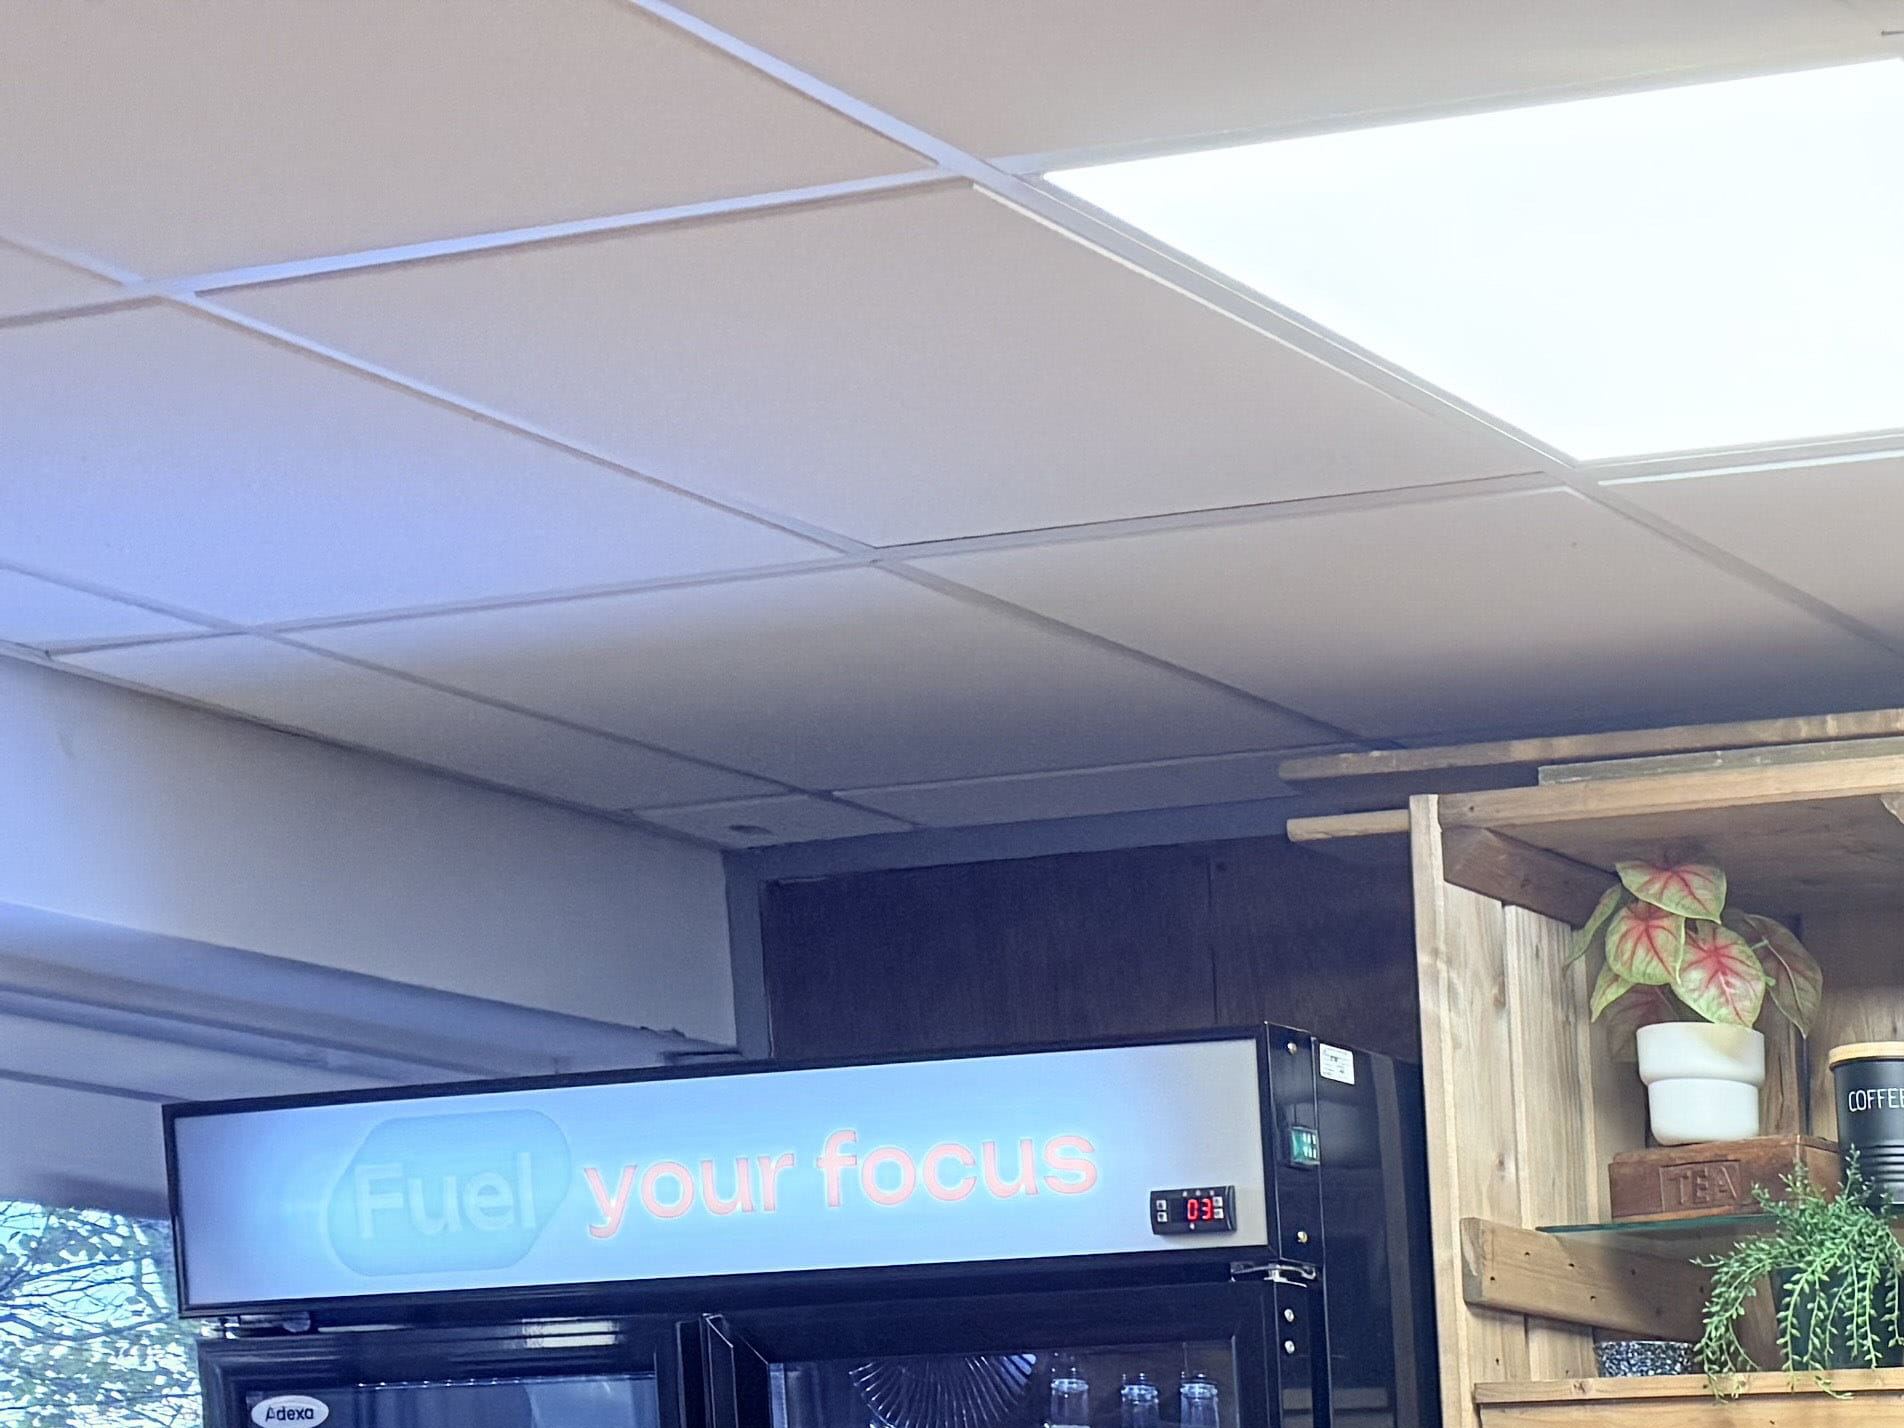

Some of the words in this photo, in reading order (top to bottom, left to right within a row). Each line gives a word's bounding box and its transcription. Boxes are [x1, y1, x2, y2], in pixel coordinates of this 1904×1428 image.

[353, 1151, 538, 1241] Fuel
[583, 1151, 796, 1239] your
[816, 1128, 1100, 1208] focus
[1665, 1169, 1738, 1200] TEA
[1187, 1196, 1214, 1223] 03
[265, 1405, 315, 1422] Adexa
